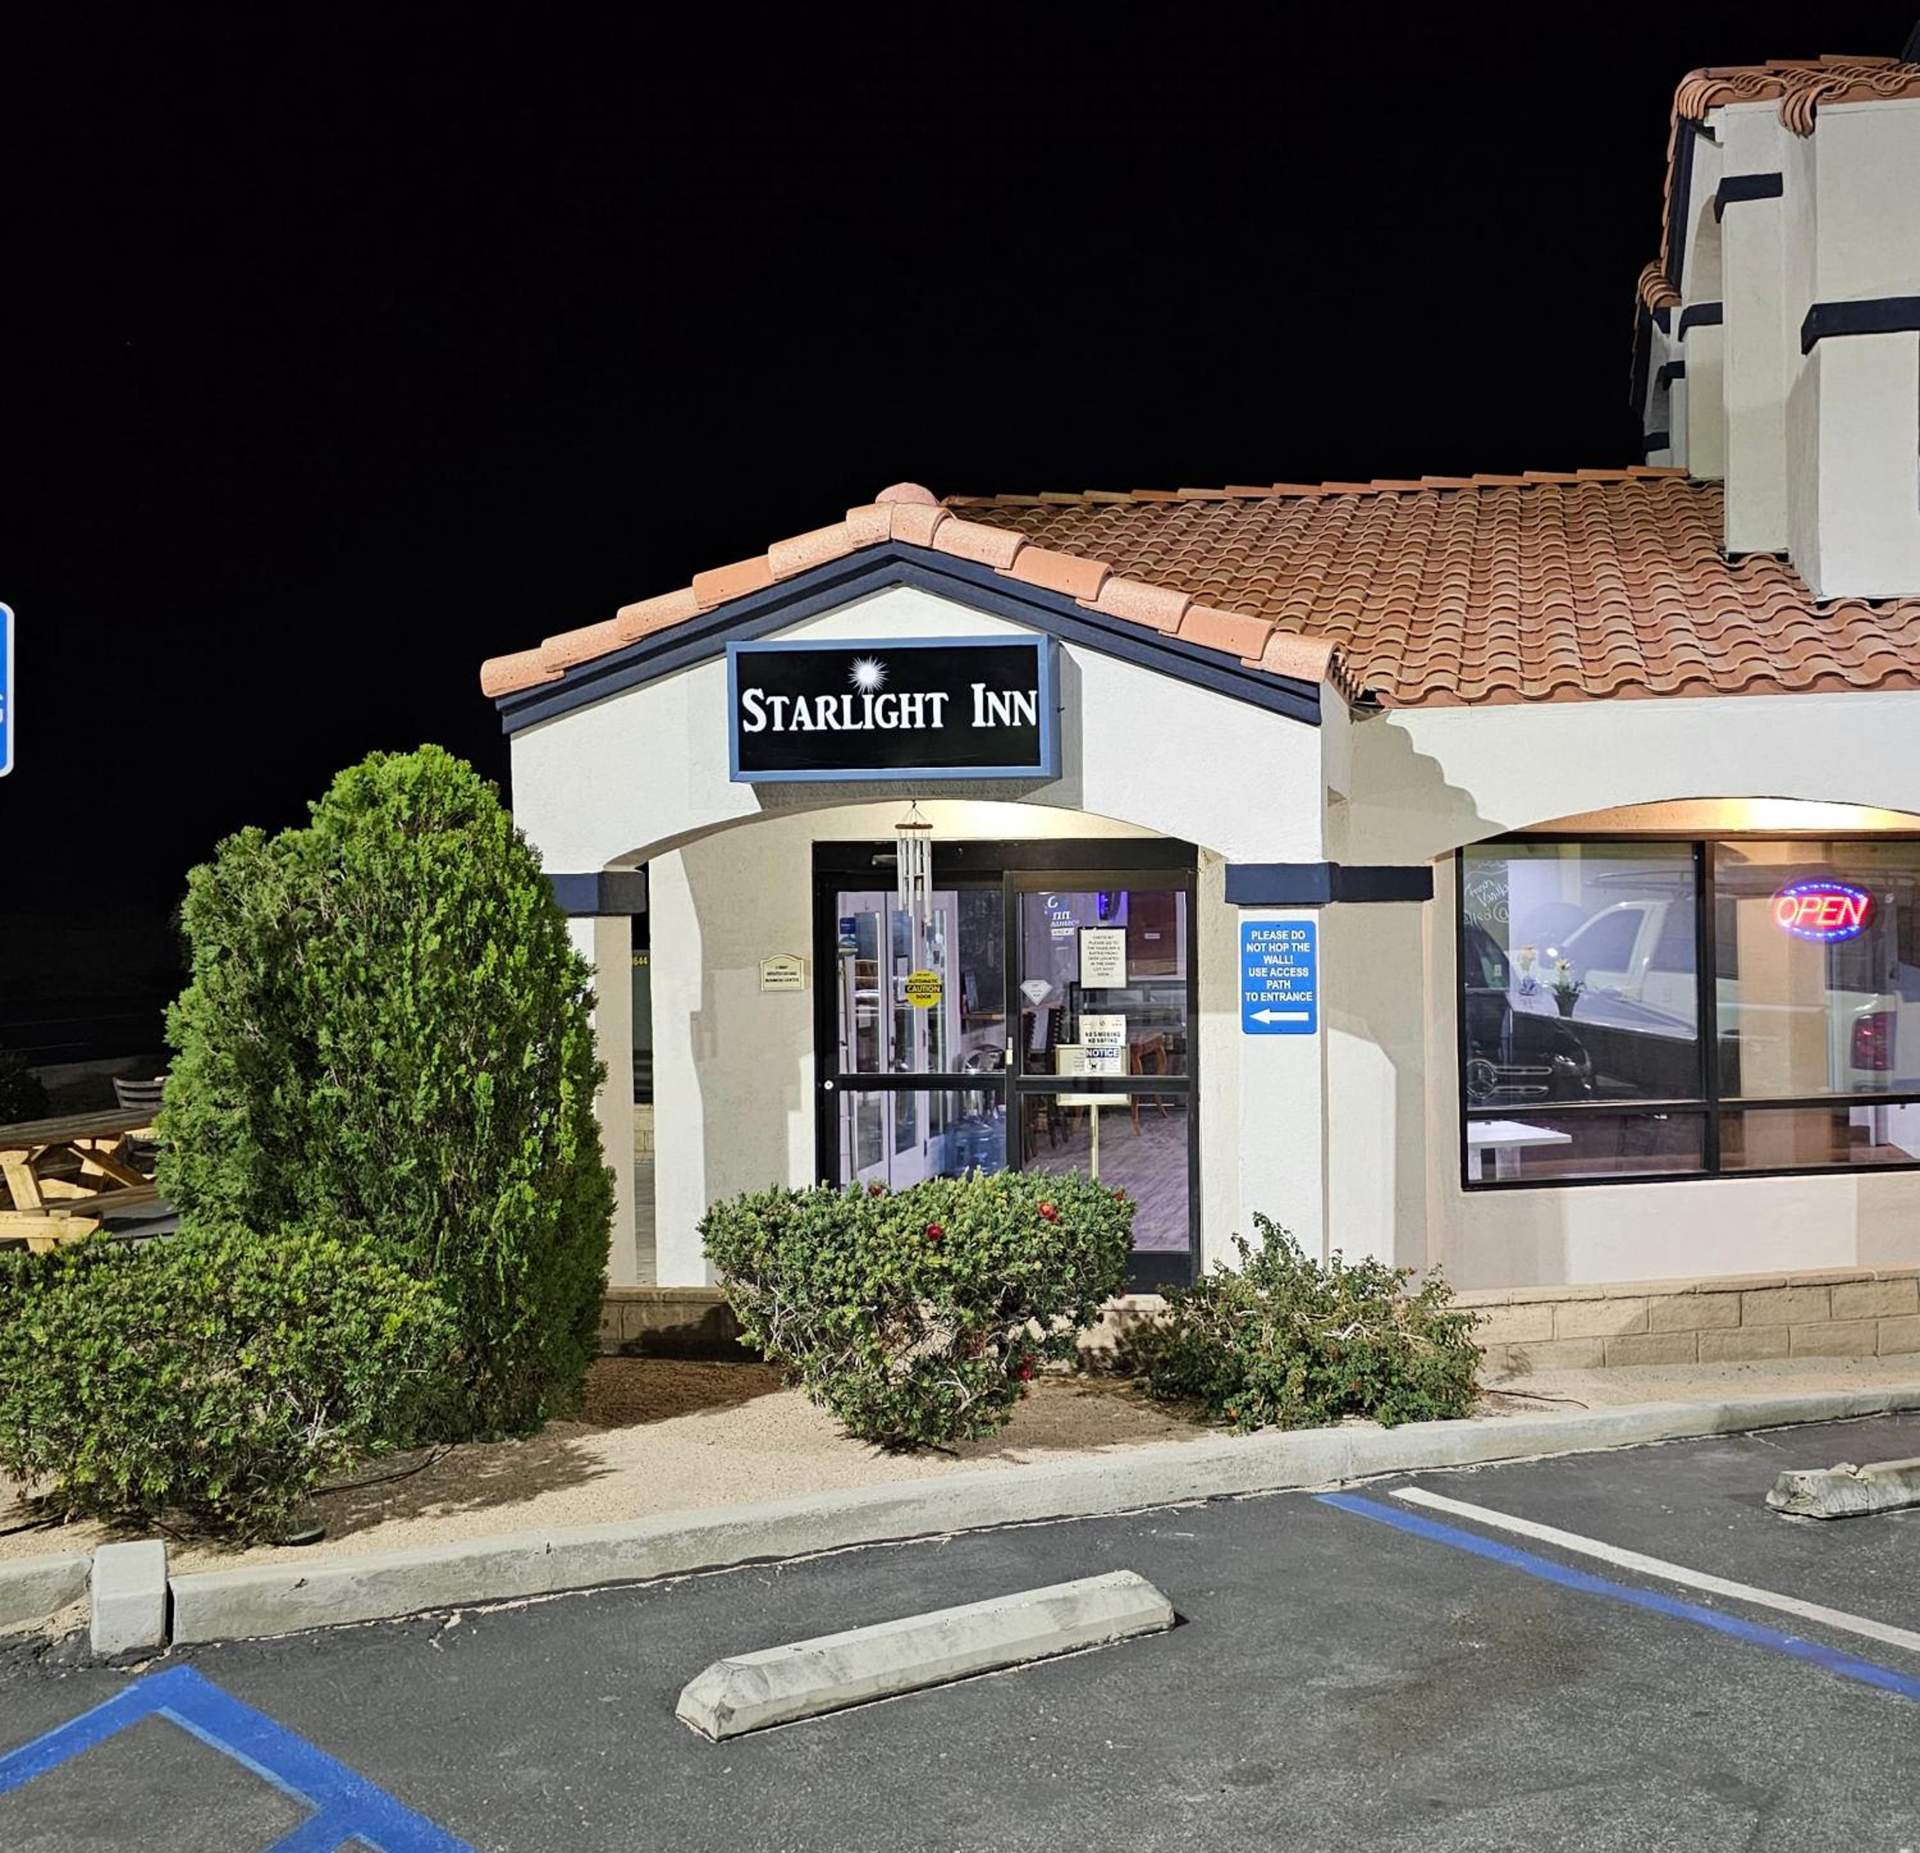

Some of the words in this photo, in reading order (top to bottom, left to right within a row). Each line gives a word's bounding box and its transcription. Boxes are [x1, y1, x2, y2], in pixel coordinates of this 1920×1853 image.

[742, 687, 949, 732] STARLIGHT
[970, 683, 1038, 727] INN
[1776, 896, 1869, 925] OPEN
[1251, 930, 1289, 940] PLEASE
[1291, 930, 1306, 940] DO
[1246, 942, 1266, 952] NOT
[1268, 942, 1290, 952] HOP
[1292, 942, 1311, 952] THE
[1263, 955, 1294, 965] WALL!
[1248, 967, 1268, 977] USE
[1270, 967, 1309, 977] ACCESS
[1266, 980, 1291, 990] PATH
[1245, 992, 1259, 1001] TO
[1260, 992, 1313, 1001] ENTRANCE
[1086, 1048, 1119, 1057] NOTICE
